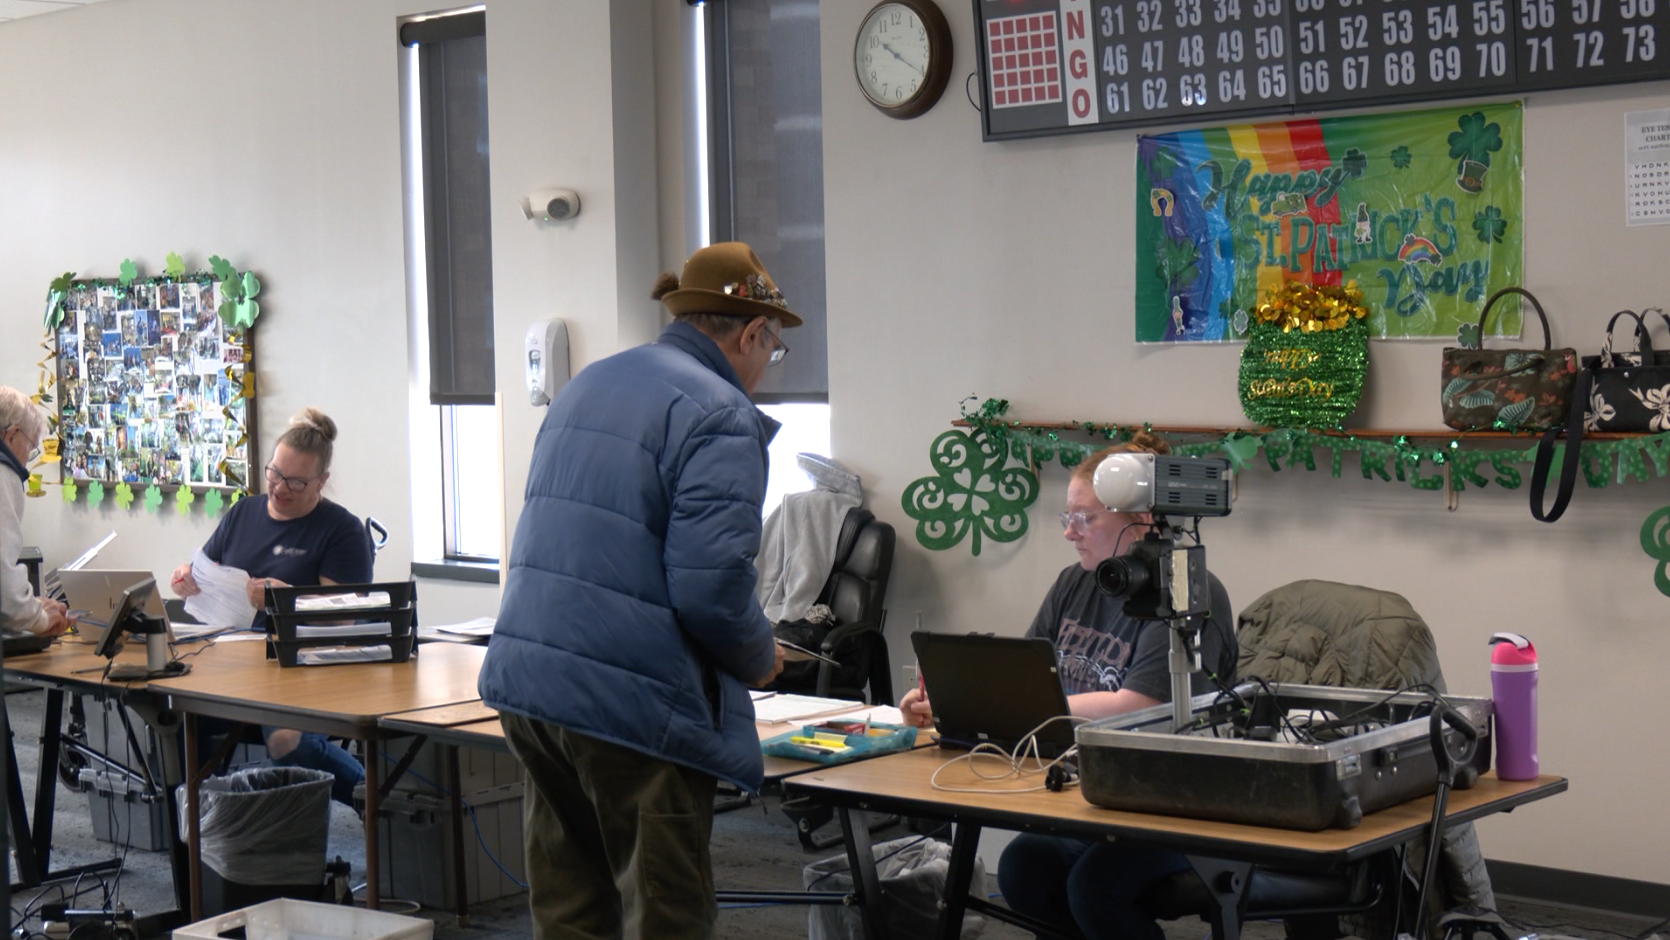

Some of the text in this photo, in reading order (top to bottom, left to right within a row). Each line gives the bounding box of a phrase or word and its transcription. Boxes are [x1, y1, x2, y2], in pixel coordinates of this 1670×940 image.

[891, 12, 901, 26] 12
[909, 15, 913, 28] 1
[1101, 4, 1125, 37] 31
[1136, 1, 1163, 33] 32
[1175, 0, 1202, 28] 33
[1214, 0, 1241, 23] 34
[1521, 0, 1555, 30] 56
[1572, 0, 1602, 25] 57
[879, 20, 887, 33] 11
[919, 28, 926, 41] 2
[1103, 0, 1656, 76] 46 47 48 49 50 51 52 53 54 55 71 72 73
[870, 35, 879, 49] 10
[865, 54, 872, 67] 9
[870, 71, 878, 84] 8
[1106, 41, 1506, 114] 61 62 63 64 65 66 67 68 69 70
[882, 83, 888, 97] 7
[895, 85, 902, 99] 6
[910, 79, 917, 92] 5
[1641, 125, 1656, 134] EYE
[1645, 133, 1670, 143] CHART
[1196, 158, 1346, 220] Happy
[1377, 258, 1490, 318] Day
[1578, 432, 1670, 489] DAY
